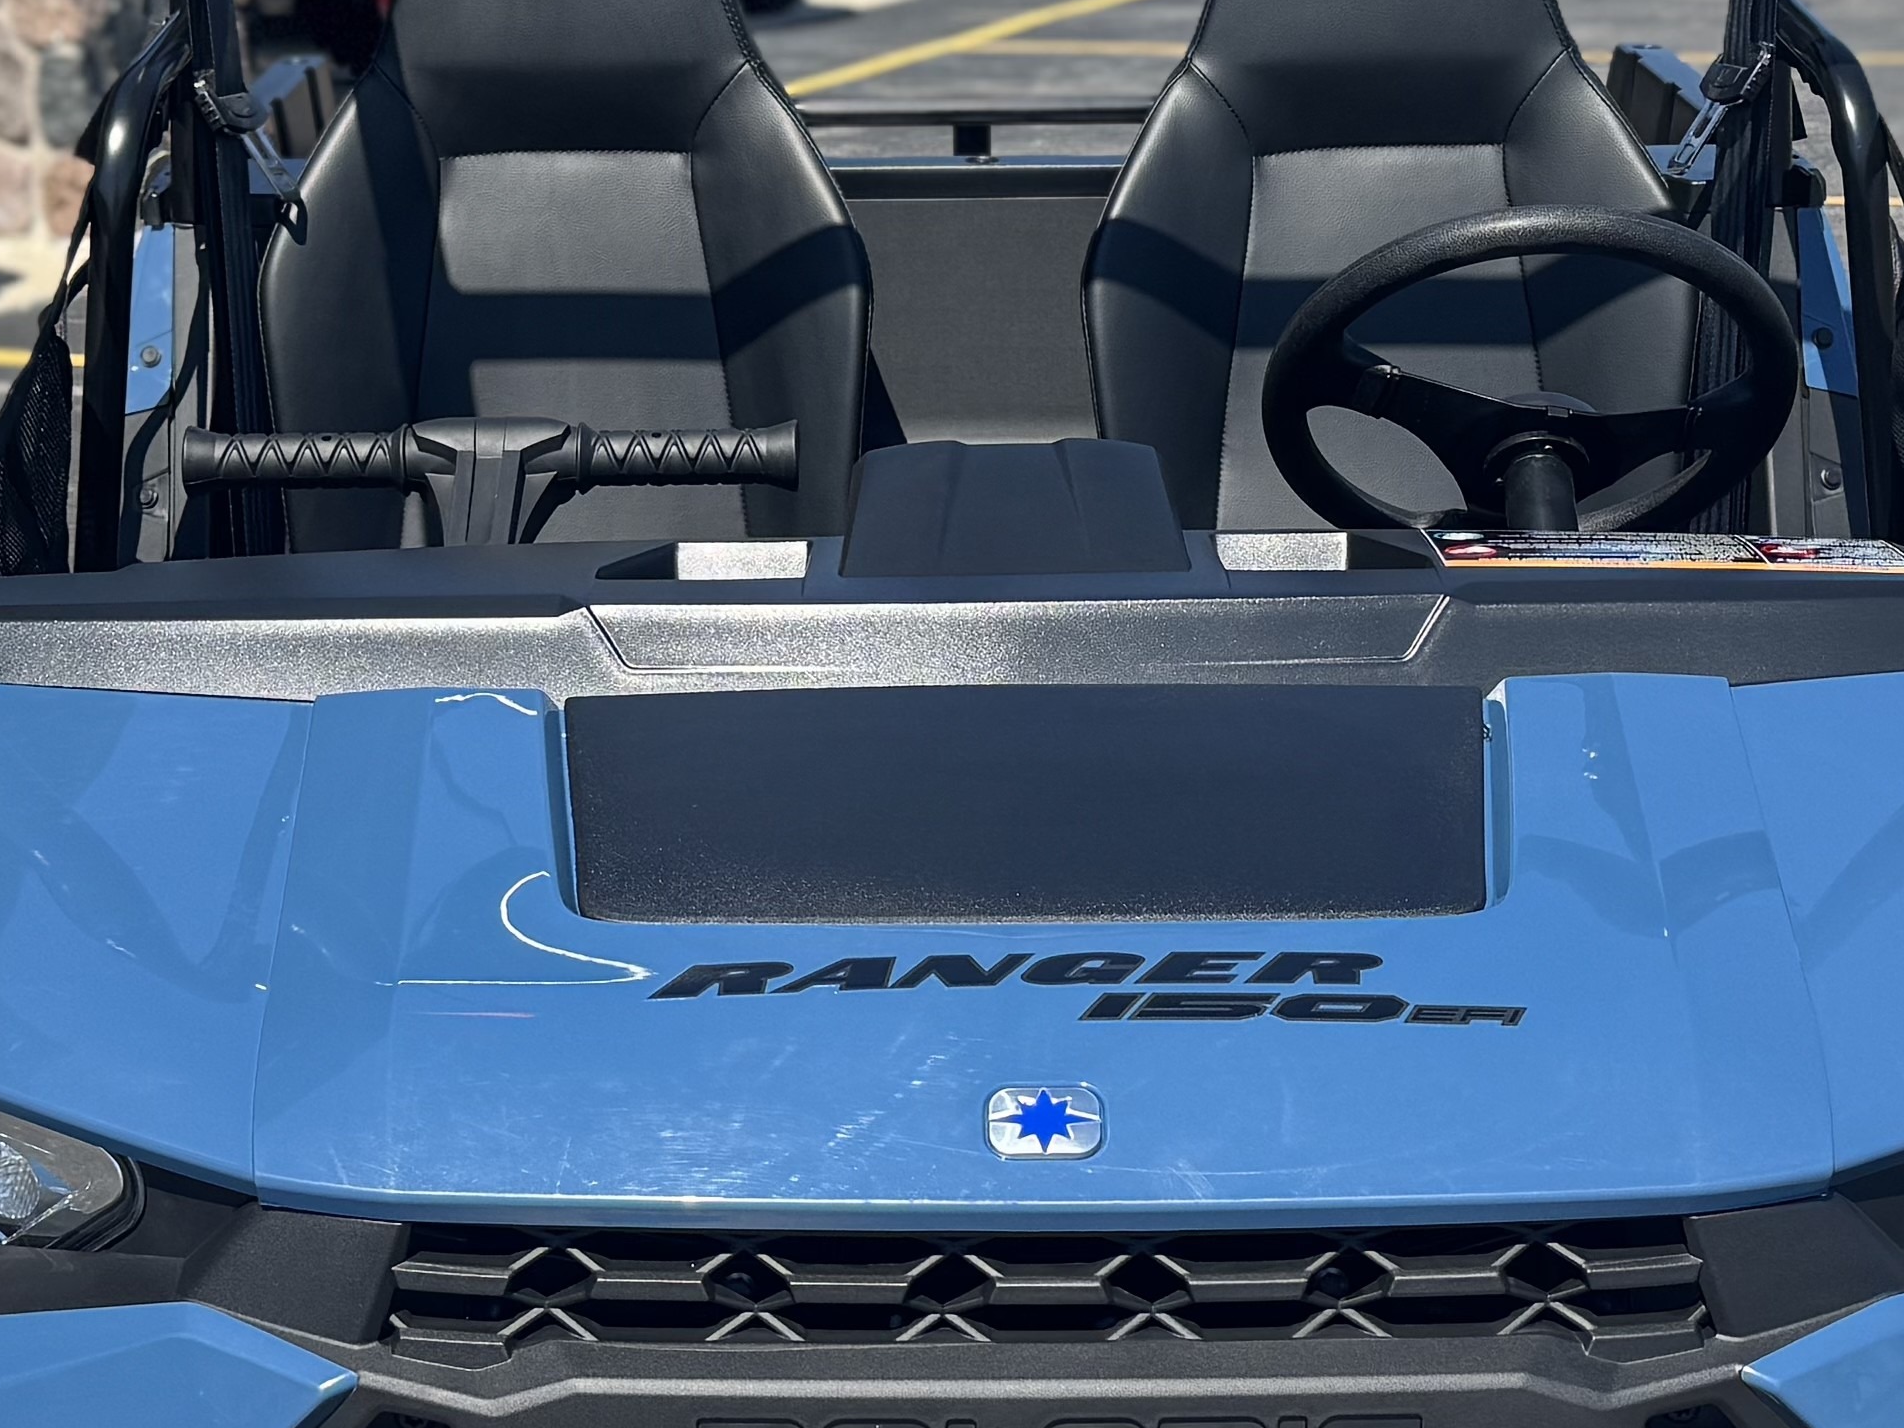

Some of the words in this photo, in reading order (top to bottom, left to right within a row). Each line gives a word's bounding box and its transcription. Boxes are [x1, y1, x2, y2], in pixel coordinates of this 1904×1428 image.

[647, 951, 1384, 1000] RANGER
[1077, 991, 1410, 1023] 150
[1404, 1004, 1528, 1027] EFI
